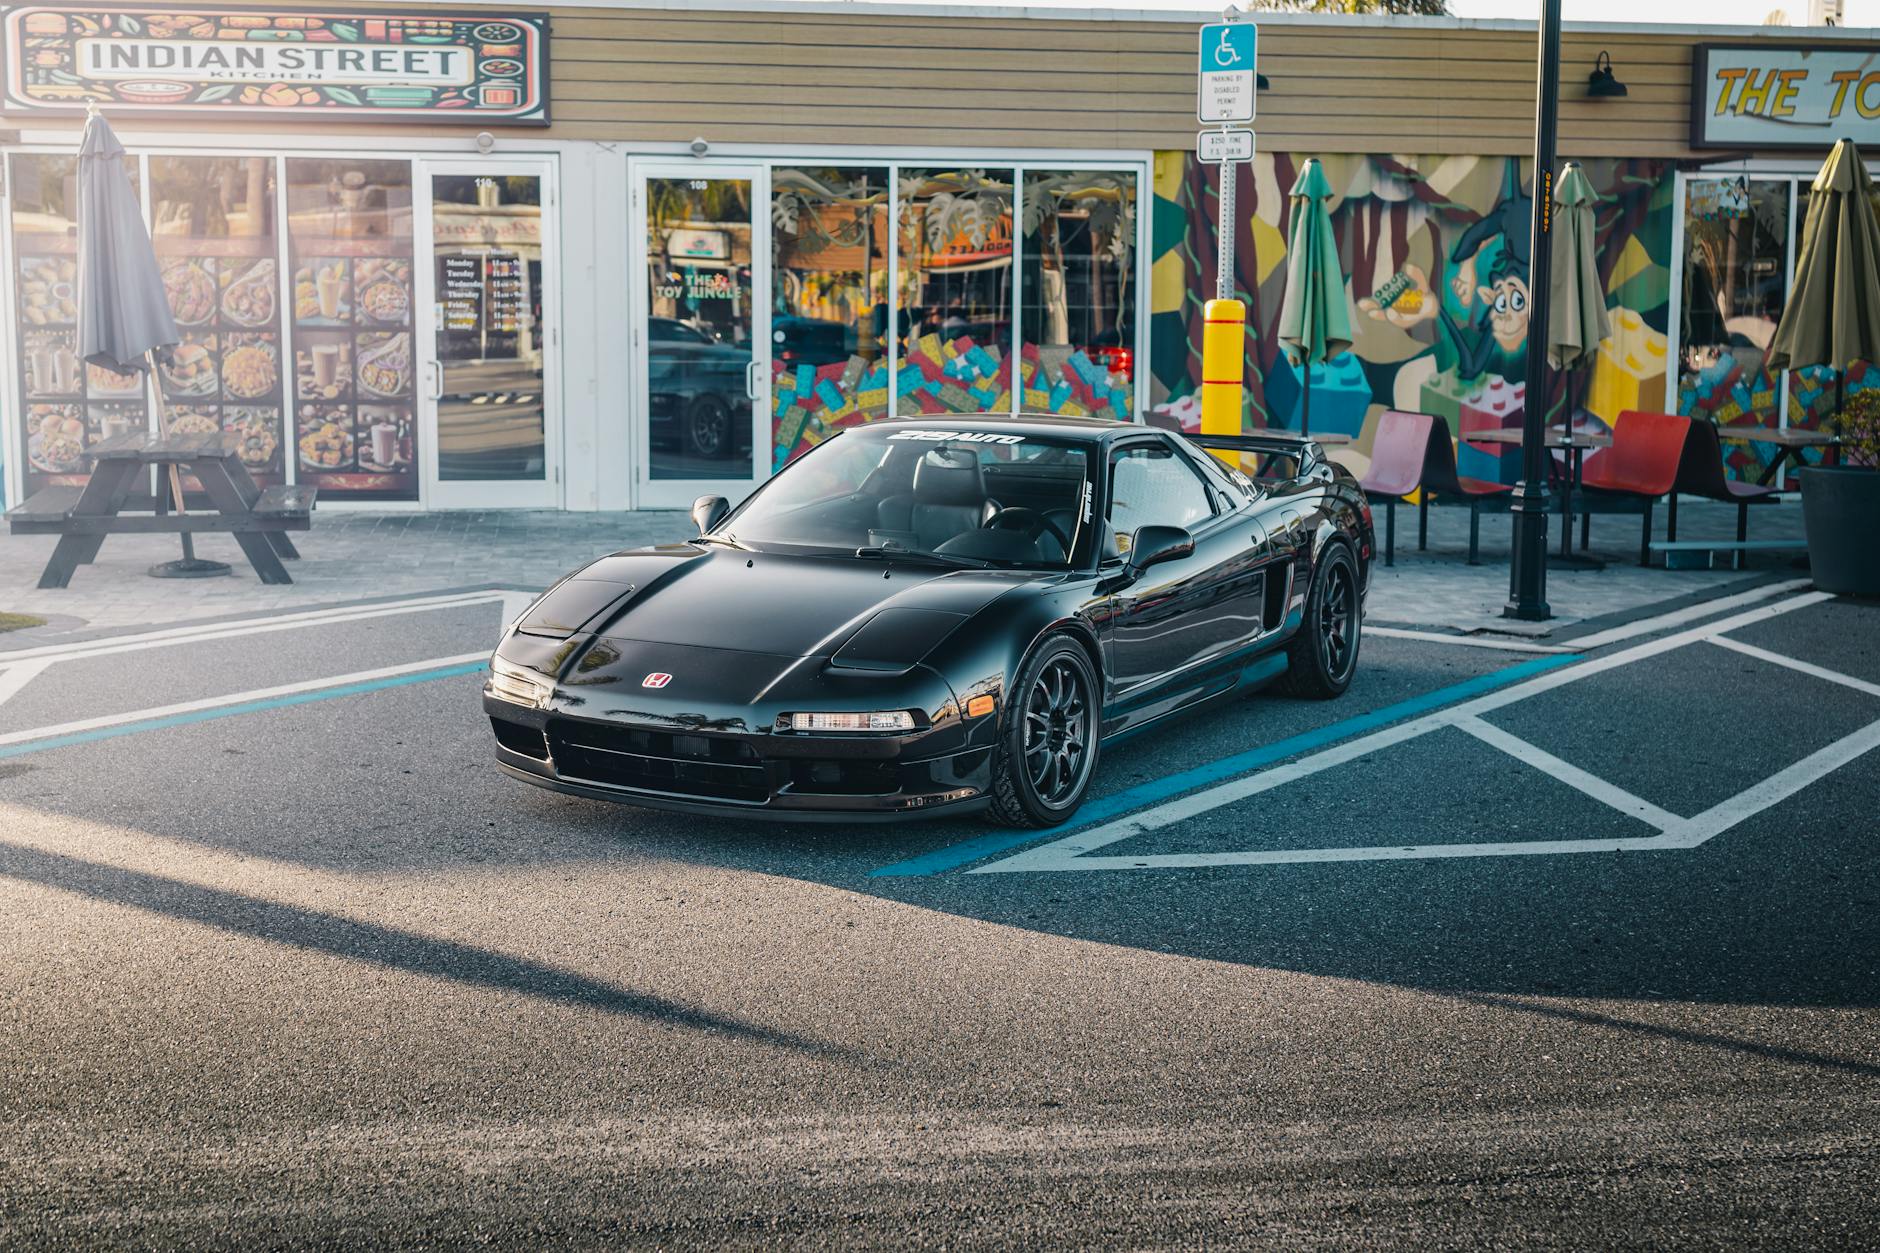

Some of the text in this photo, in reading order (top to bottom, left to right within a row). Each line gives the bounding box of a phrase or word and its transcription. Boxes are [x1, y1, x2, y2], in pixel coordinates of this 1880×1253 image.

[91, 43, 458, 76] INDIAN STREET
[210, 71, 323, 80] KITCHEN
[1714, 68, 1880, 120] THE TO
[1217, 97, 1236, 105] PERMIT
[446, 259, 474, 268] Monday
[446, 270, 475, 278] Tuesday
[447, 280, 484, 289] Wednesday
[685, 274, 712, 286] THE
[448, 291, 479, 300] Thursday
[656, 286, 742, 299] TOY JUNGLE
[448, 301, 470, 310] Friday
[448, 322, 473, 331] Sunday
